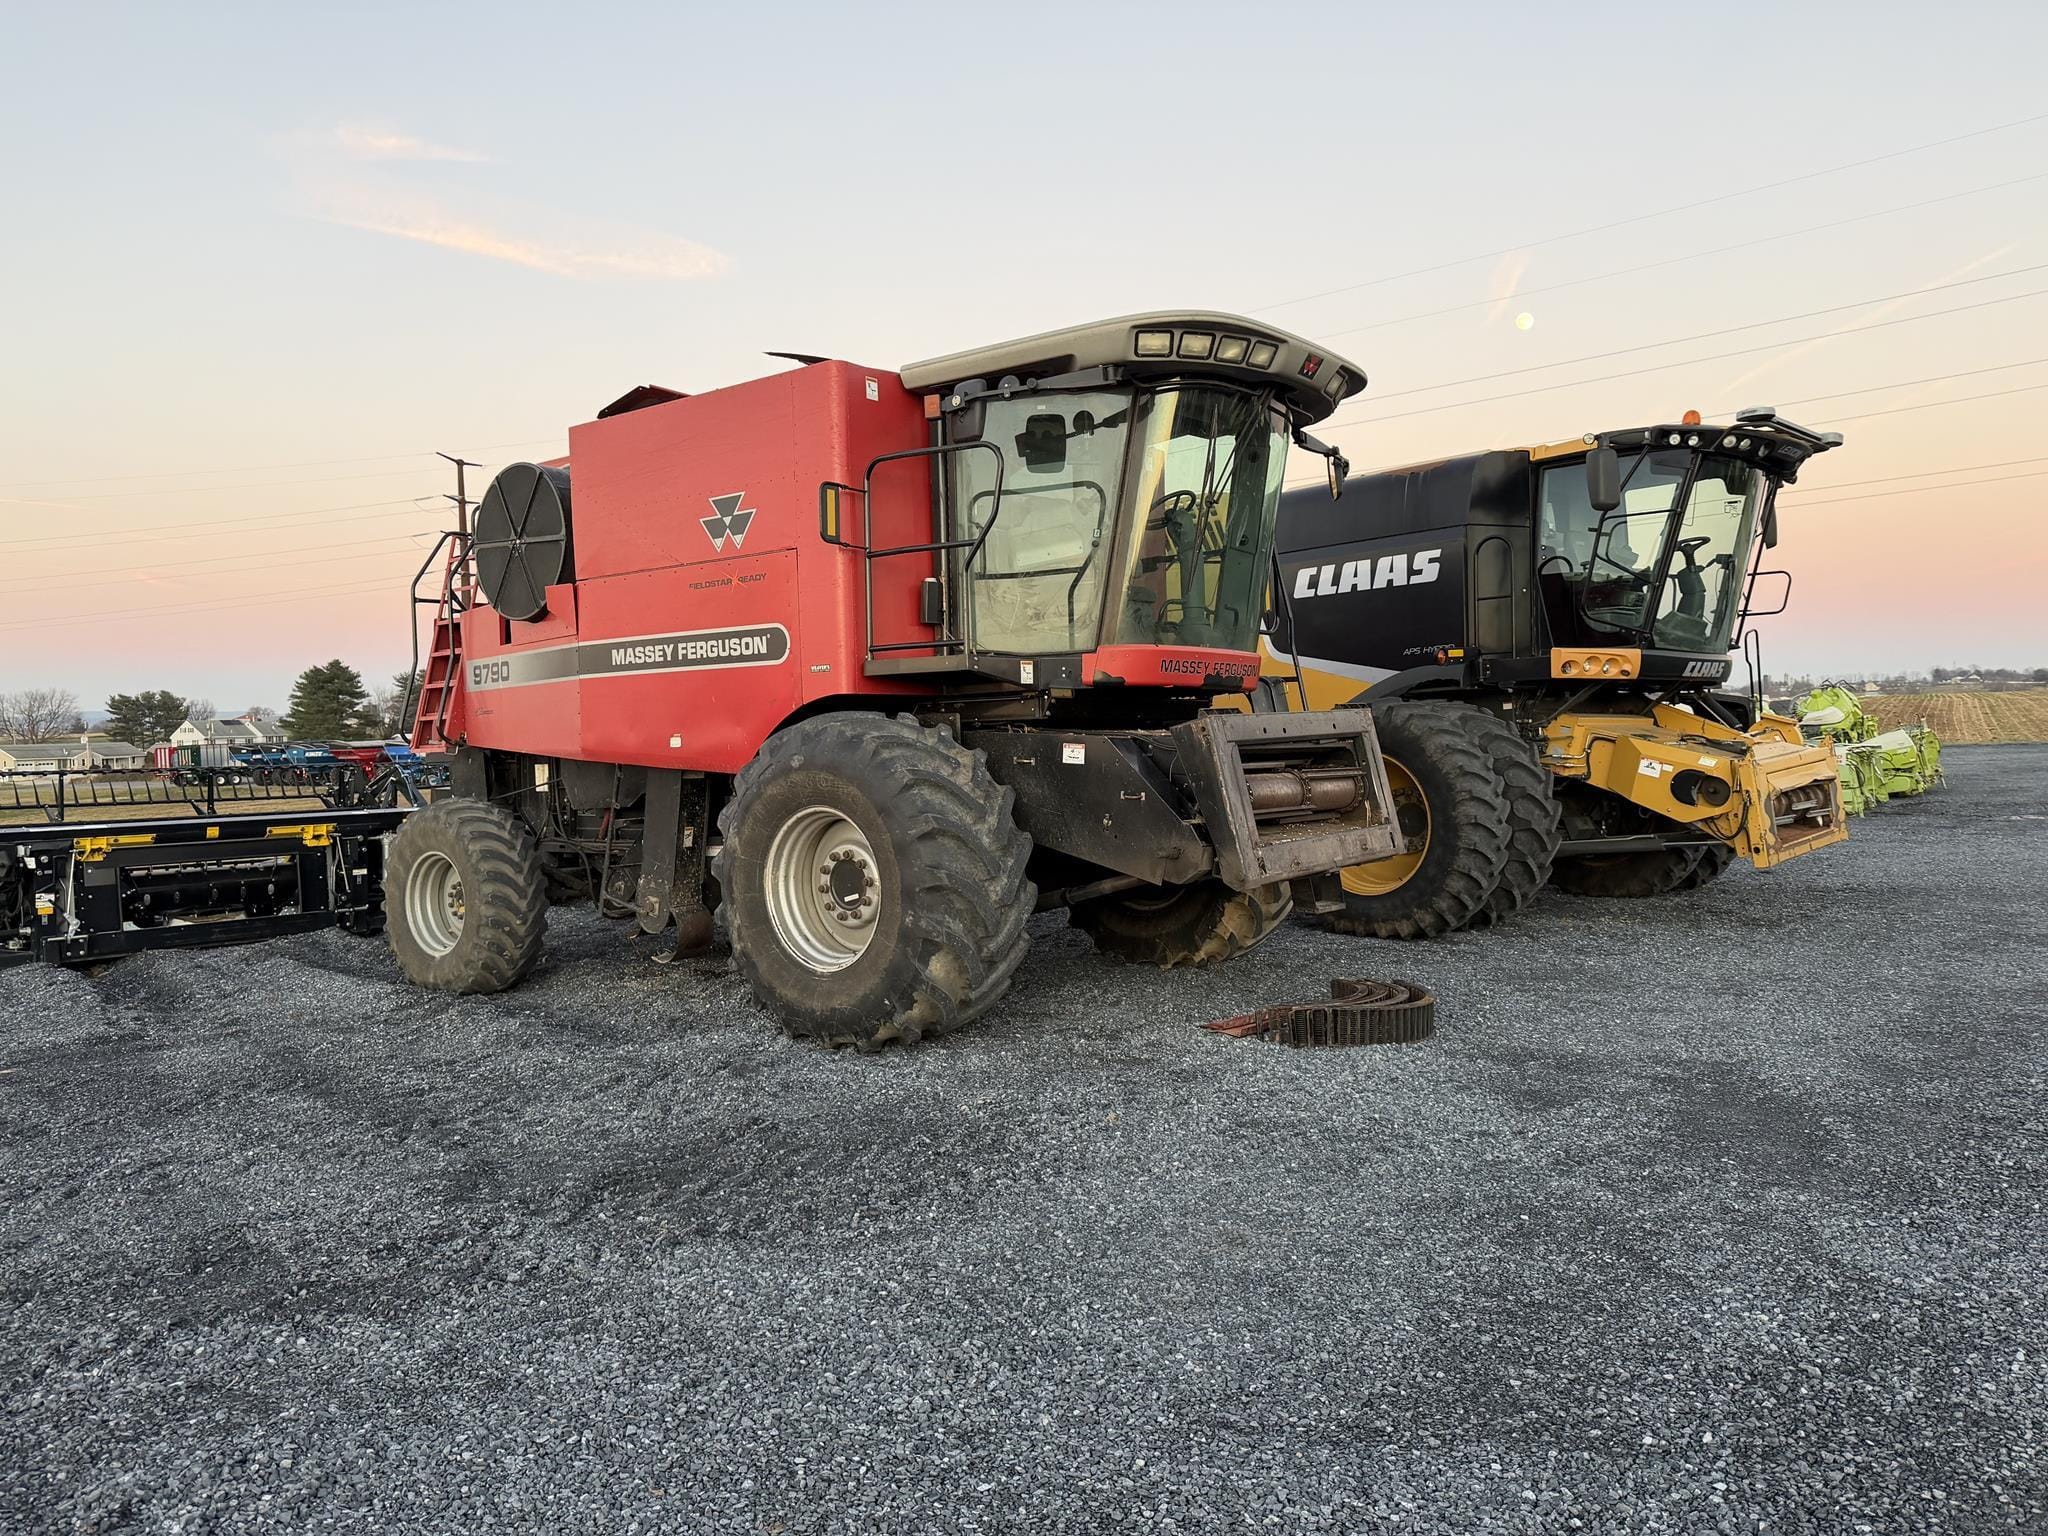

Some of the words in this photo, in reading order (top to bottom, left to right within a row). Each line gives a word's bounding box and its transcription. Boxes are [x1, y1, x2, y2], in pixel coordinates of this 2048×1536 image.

[689, 578, 733, 590] FIELDSTAR
[738, 573, 767, 583] READY
[1293, 548, 1442, 599] CLAAS
[611, 644, 675, 666] MASSEY
[677, 635, 768, 660] FERGUSON
[1402, 646, 1422, 656] APS
[473, 661, 510, 685] 9790
[1160, 659, 1210, 675] MASSEY
[1213, 662, 1258, 677] FERGUSON
[1682, 661, 1726, 678] CLAAS
